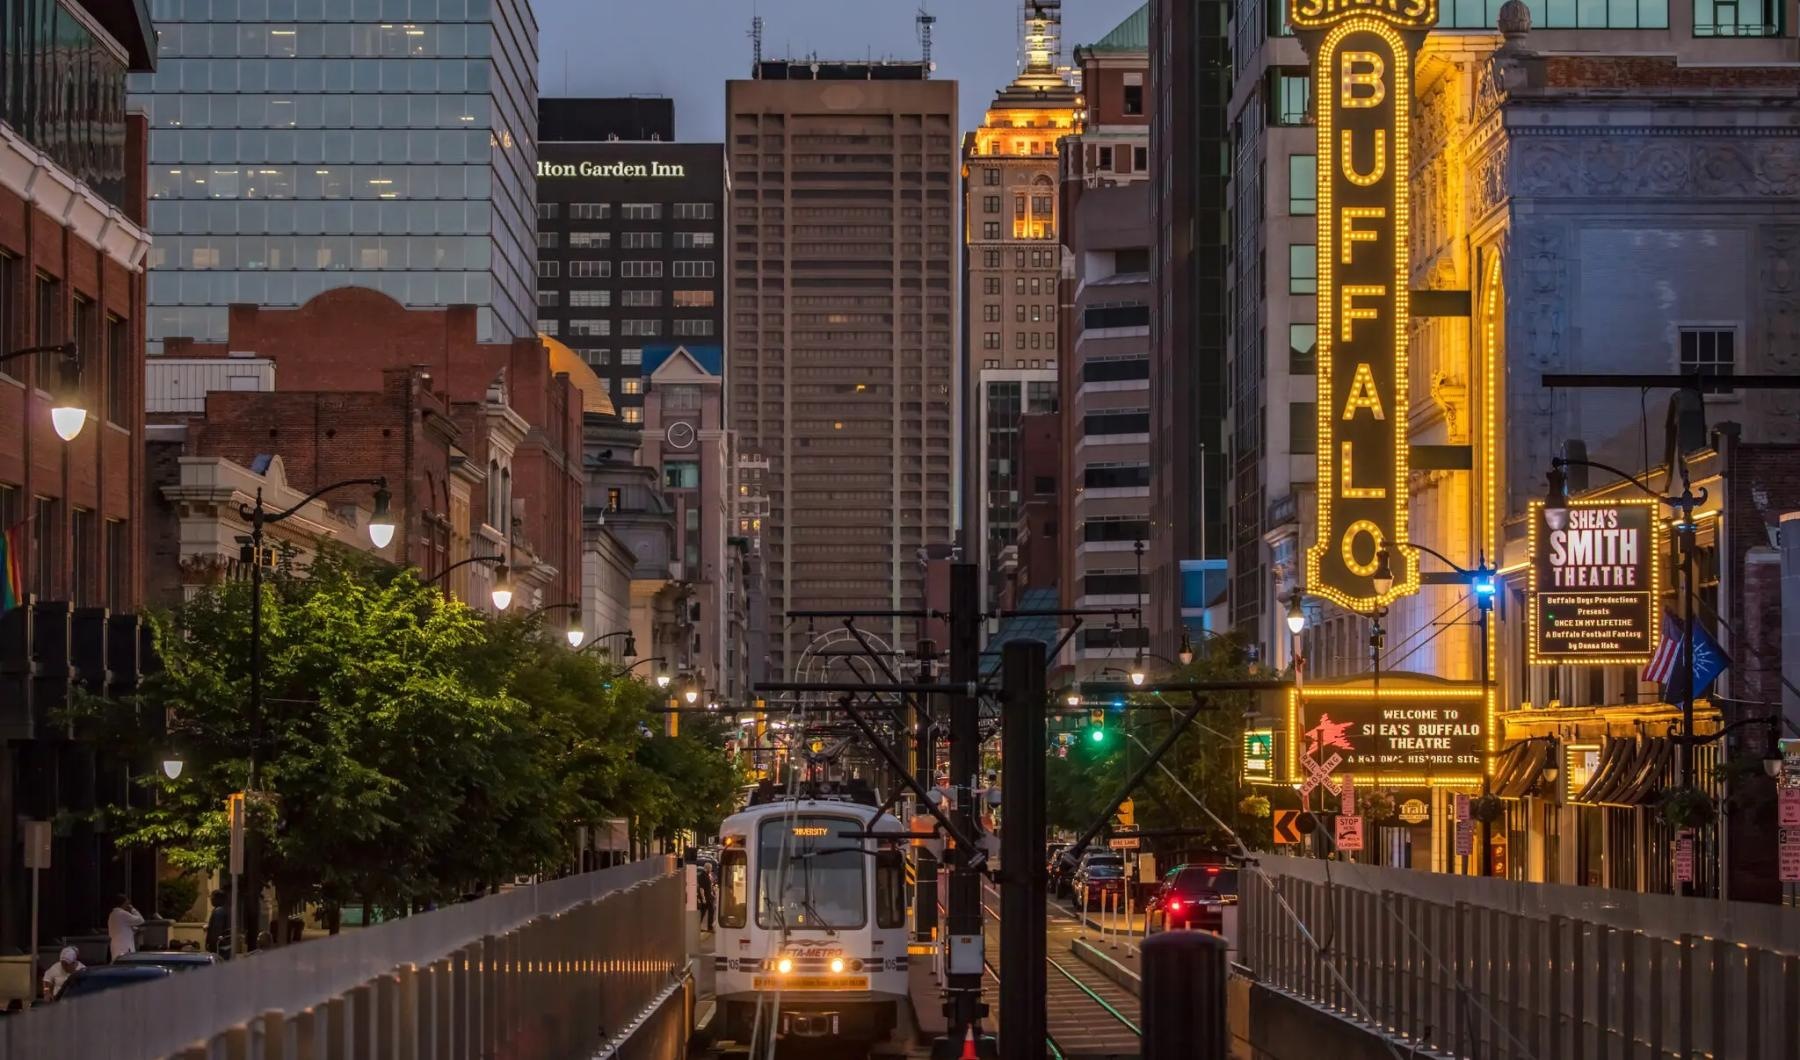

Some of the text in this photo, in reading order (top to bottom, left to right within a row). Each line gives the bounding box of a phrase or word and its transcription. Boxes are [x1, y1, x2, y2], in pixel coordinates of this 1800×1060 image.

[579, 161, 648, 177] Garden
[651, 161, 685, 177] Inn
[1341, 51, 1386, 577] BUFFALO
[1569, 509, 1618, 530] SHEA'S
[1549, 529, 1638, 566] SMITH
[1553, 566, 1635, 587] THEATRE
[1594, 596, 1638, 604] Productions
[1554, 619, 1574, 627] ONCE
[1581, 630, 1611, 638] Football
[1612, 630, 1642, 638] Fantasy
[1568, 642, 1577, 650] by
[1383, 709, 1459, 720] WELCOME TO
[1418, 723, 1480, 736] BUFFALO
[1389, 737, 1451, 749] THEATRE
[1408, 755, 1453, 763] HISORIC
[1457, 755, 1480, 763] SITE
[1302, 755, 1340, 795] RAIL ROAD
[1339, 818, 1359, 826] STOP
[728, 959, 739, 970] 105
[885, 959, 897, 970] 105
